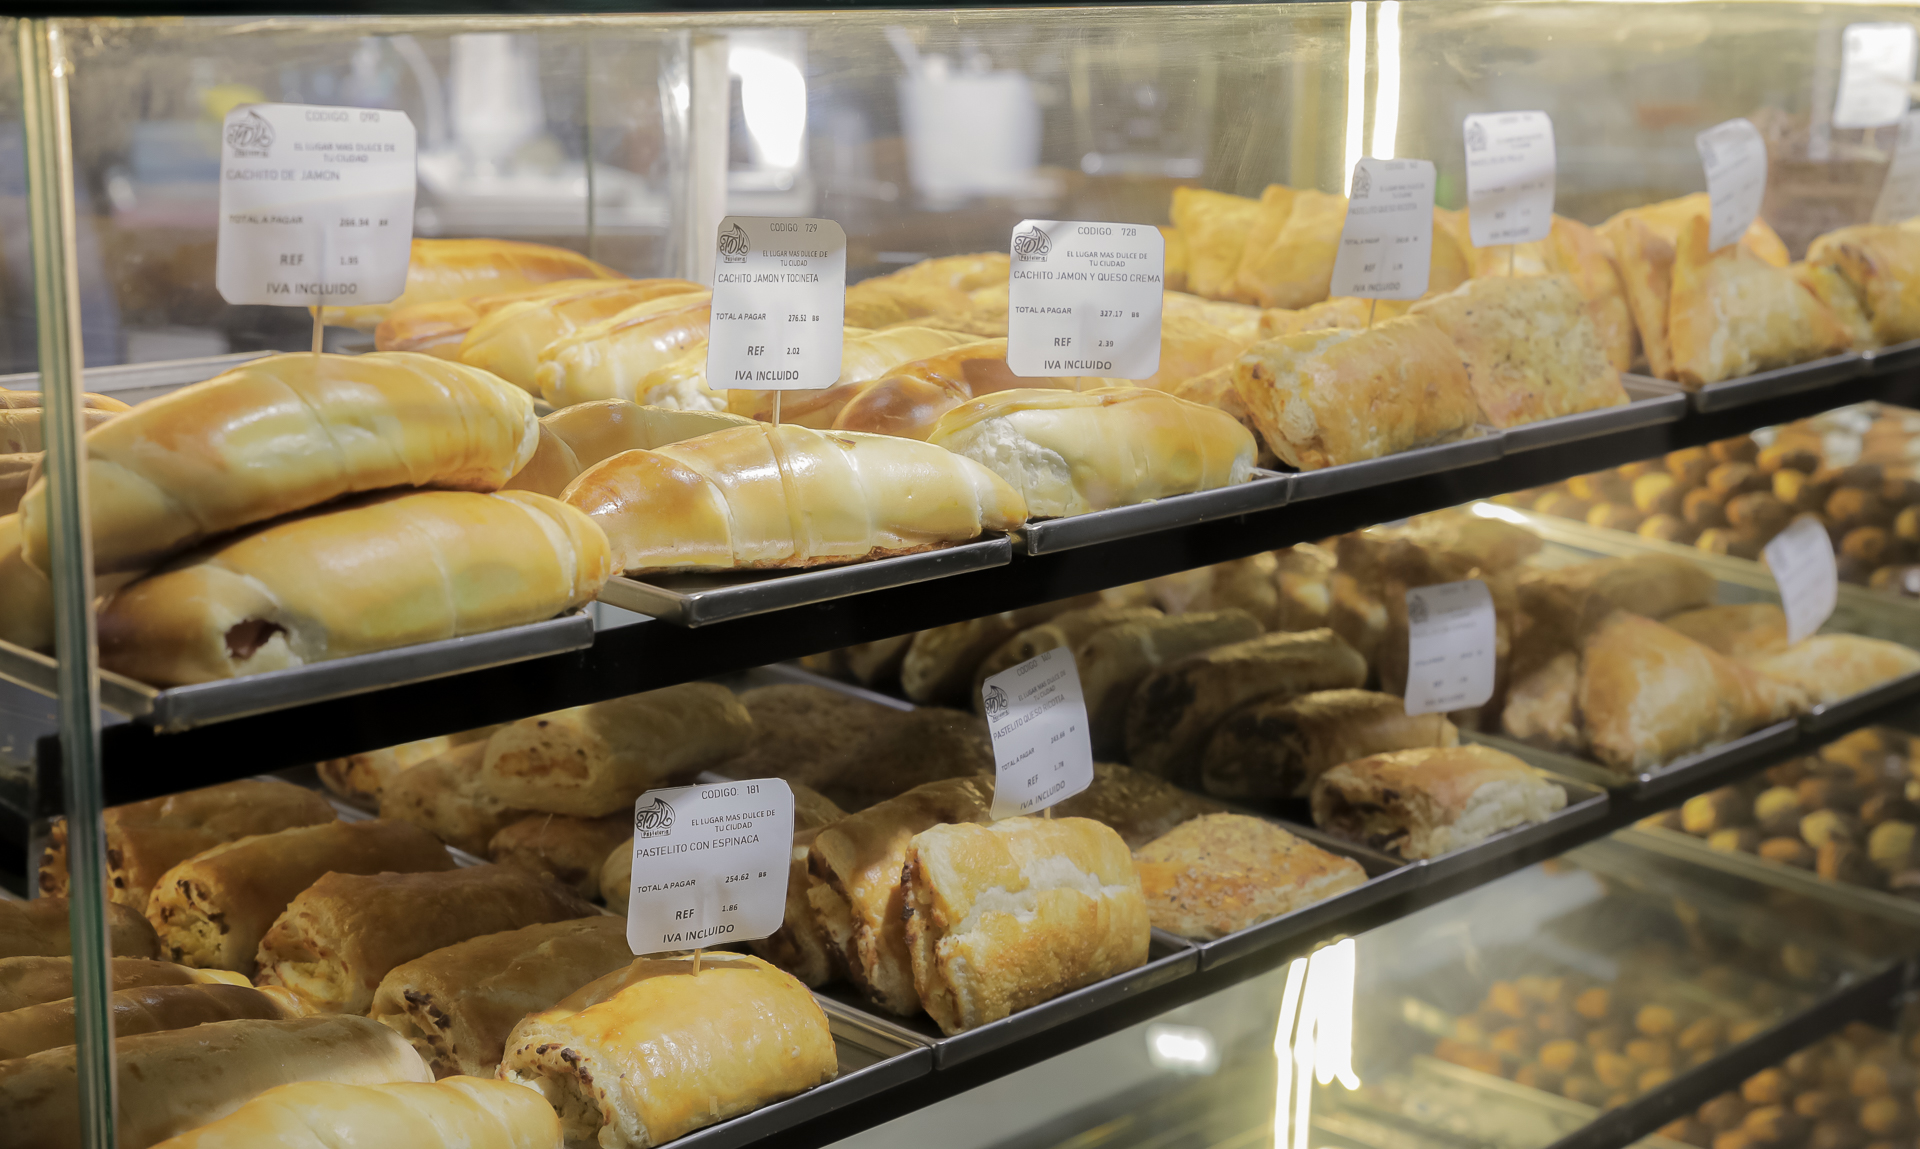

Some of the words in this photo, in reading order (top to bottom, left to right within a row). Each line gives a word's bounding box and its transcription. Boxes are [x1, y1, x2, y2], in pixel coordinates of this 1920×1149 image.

[226, 169, 278, 181] CACHITO
[280, 169, 294, 181] DE
[300, 169, 340, 181] JAMON
[229, 214, 258, 224] TOTAL
[260, 215, 268, 224] A
[270, 215, 304, 225] PAGAR
[805, 223, 818, 233] 729
[279, 253, 305, 266] REF
[801, 250, 818, 258] DULCE
[1100, 251, 1114, 259] MAS
[1139, 252, 1148, 260] DE
[718, 273, 752, 283] CACHITO
[753, 273, 779, 283] JAMON
[780, 273, 786, 283] Y
[787, 273, 819, 283] TOCINETA
[1013, 271, 1053, 280] CACHITO
[1055, 271, 1087, 281] JAMON
[1089, 272, 1095, 281] Y
[1097, 272, 1128, 282] QUESO
[1130, 273, 1161, 283] CREMA
[266, 282, 290, 294] IVA
[295, 282, 358, 295] INCLUIDO
[716, 312, 737, 320] TOTAL
[743, 313, 767, 321] PAGAR
[787, 314, 807, 322] 276.52
[1015, 306, 1039, 314] TOTAL
[1099, 310, 1123, 318] 327.17
[1054, 337, 1072, 347] REF
[747, 345, 765, 356] REF
[786, 347, 800, 355] 2.02
[1044, 360, 1061, 370] IVA
[1064, 360, 1112, 370] INCLUIDO
[734, 370, 753, 381] IVA
[756, 370, 799, 381] INCLUIDO
[993, 718, 1023, 742] PASTELITO
[1023, 706, 1043, 724] QUESO
[1001, 760, 1016, 772] TOTAL
[1019, 747, 1035, 761] PAGAR
[1027, 773, 1039, 788] REF
[746, 784, 760, 795] 181
[1020, 798, 1033, 811] IVA
[1035, 780, 1066, 804] INCLUIDO
[691, 818, 699, 826] EL
[700, 815, 724, 825] LUGAR
[725, 813, 741, 823] MAS
[742, 810, 765, 820] DULCE
[766, 809, 776, 817] DE
[715, 825, 724, 833] TU
[725, 821, 753, 831] CIUDAD
[636, 843, 688, 859] PASTELITO
[689, 840, 710, 851] CON
[712, 834, 760, 849] ESPINACA
[637, 884, 662, 893] TOTAL
[670, 879, 696, 889] PAGAR
[725, 873, 749, 883] 254.62
[675, 909, 695, 920] REF
[722, 904, 738, 912] 1.86
[663, 932, 682, 943] IVA
[685, 924, 735, 941] INCLUIDO
